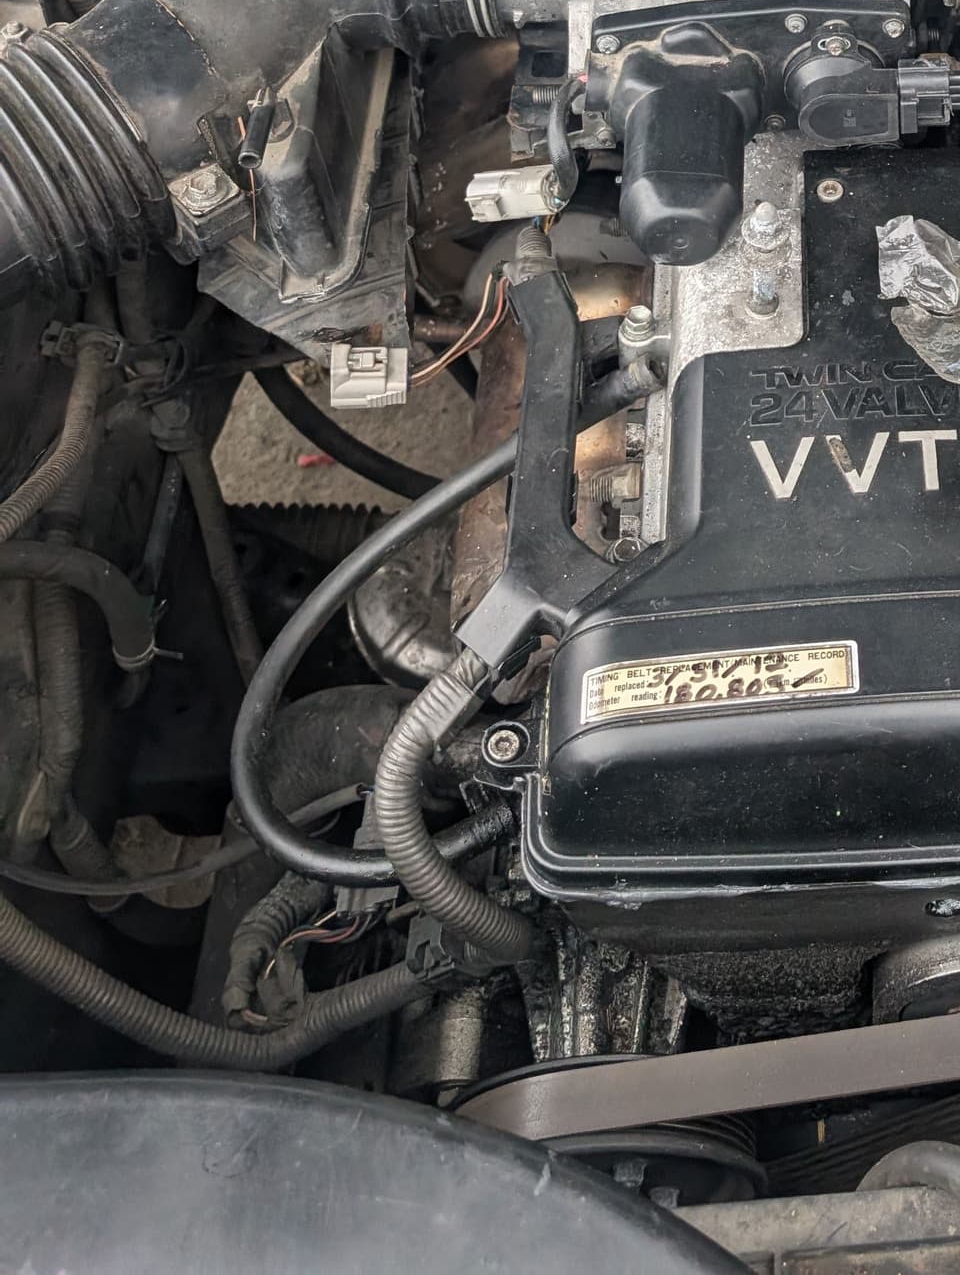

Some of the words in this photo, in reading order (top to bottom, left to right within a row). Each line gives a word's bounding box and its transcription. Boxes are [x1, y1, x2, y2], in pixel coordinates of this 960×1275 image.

[750, 363, 872, 390] TWIN
[590, 672, 619, 687] TIMING
[627, 668, 652, 679] BELT
[808, 650, 845, 661] RECORD
[588, 695, 621, 711] Odometer
[589, 687, 604, 699] Date
